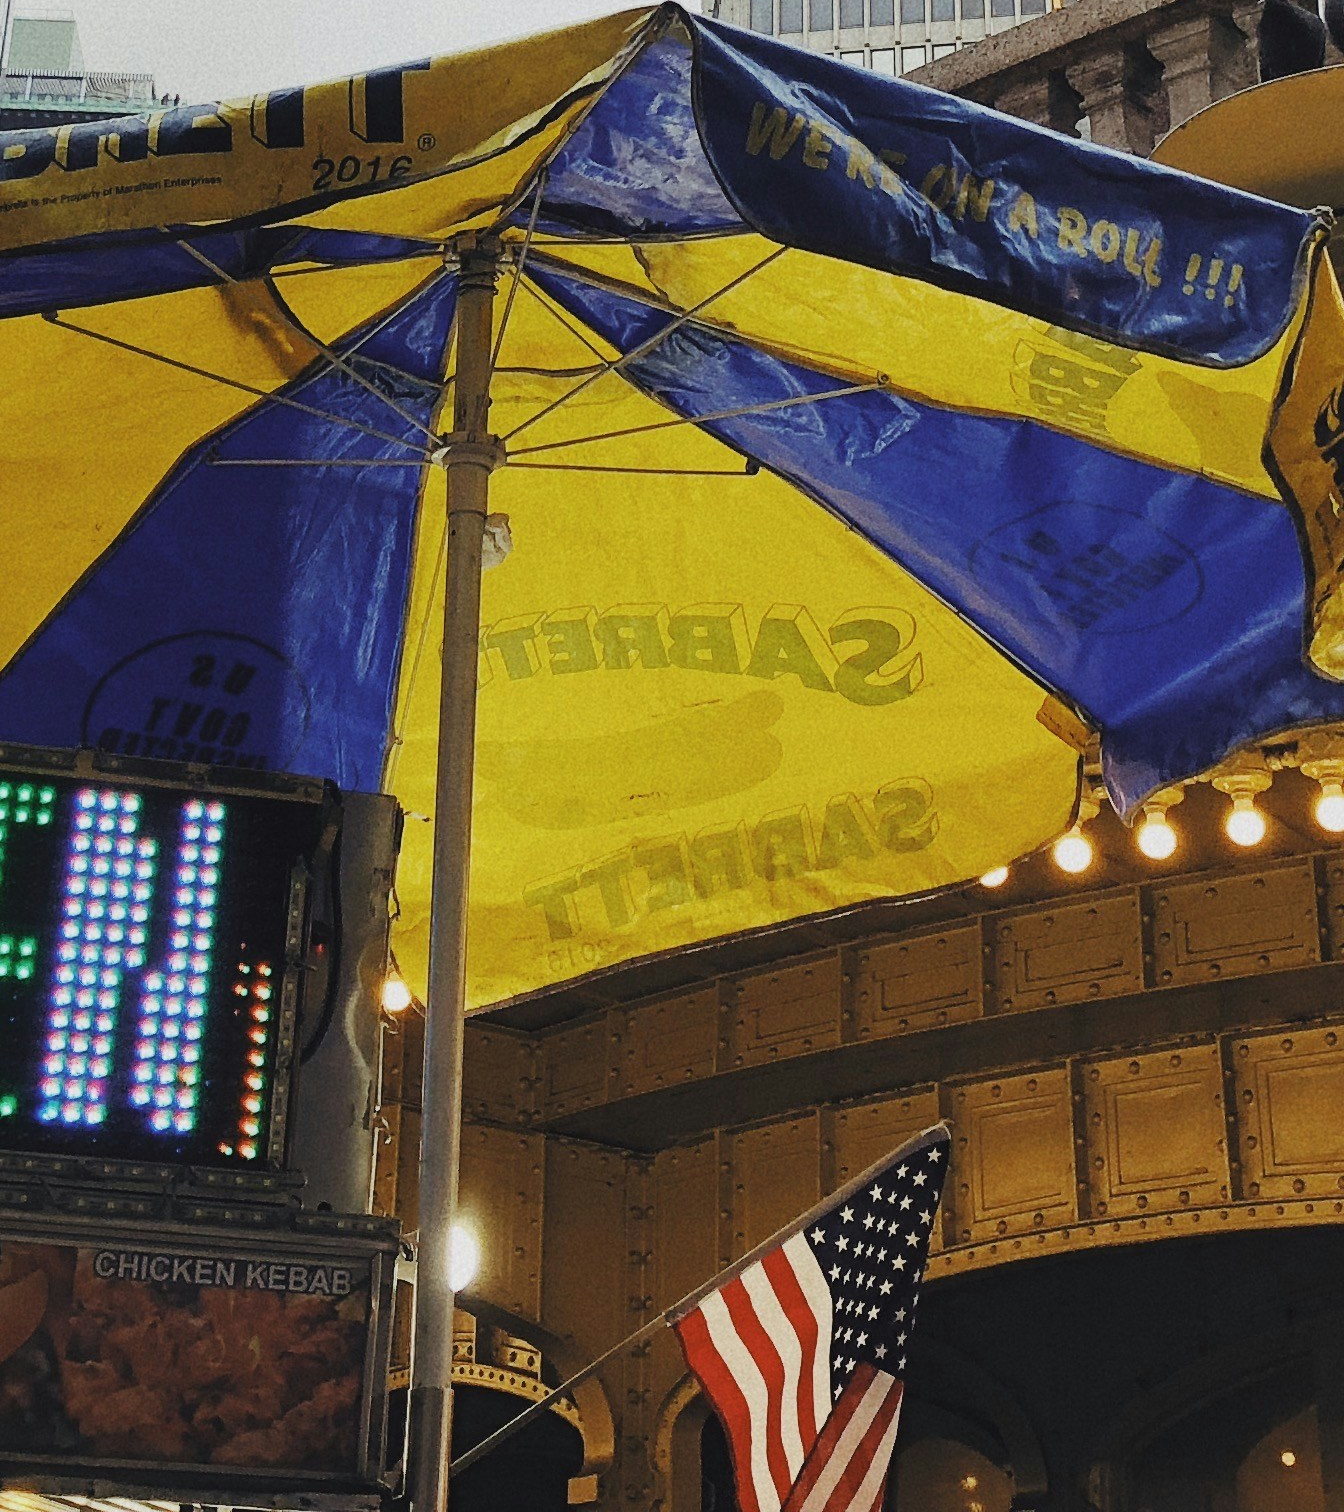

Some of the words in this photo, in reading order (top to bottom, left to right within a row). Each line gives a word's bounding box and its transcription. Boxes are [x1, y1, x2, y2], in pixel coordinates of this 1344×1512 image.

[42, 195, 58, 206] the
[60, 189, 101, 204] Property
[103, 186, 113, 197] of
[116, 180, 162, 195] Marathon
[164, 175, 223, 189] Enterprises
[312, 154, 413, 195] 2016
[745, 100, 906, 195] WERE
[920, 163, 995, 223] ON
[1009, 191, 1039, 239] A
[1057, 206, 1162, 288] ROLL
[1182, 253, 1244, 309] !!!
[94, 1251, 237, 1287] CHICKEN
[245, 1263, 353, 1297] KEBAB
